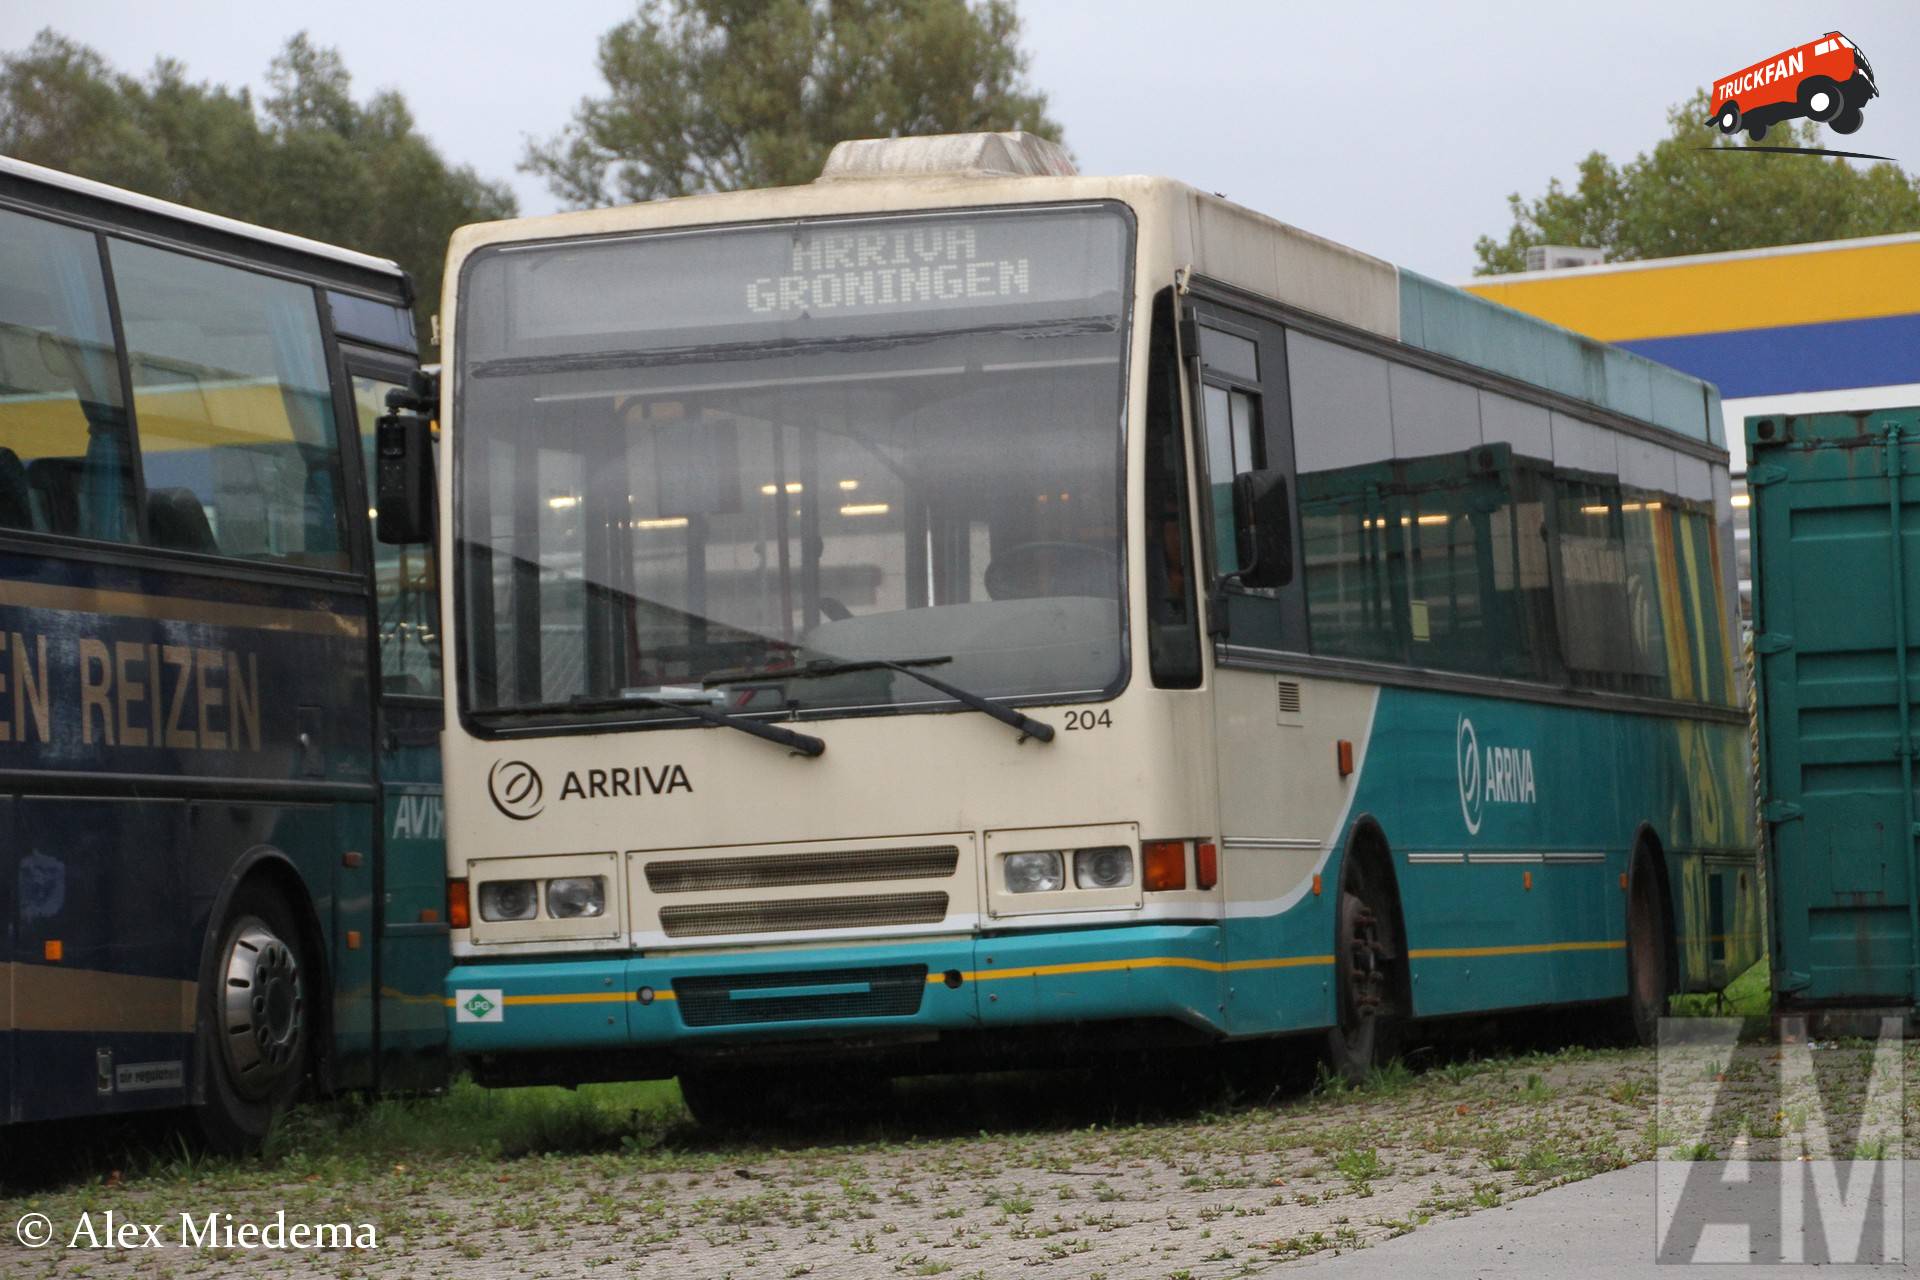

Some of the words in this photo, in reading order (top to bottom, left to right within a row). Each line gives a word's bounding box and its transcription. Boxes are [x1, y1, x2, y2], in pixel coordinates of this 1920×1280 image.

[792, 225, 976, 272] ARRIVA
[747, 258, 1030, 313] GRONINGEN
[79, 638, 261, 752] REIZEN
[1064, 708, 1113, 731] 204
[559, 764, 694, 801] ARRIVA
[1485, 746, 1536, 804] ARRIVA
[468, 1000, 490, 1012] LPG
